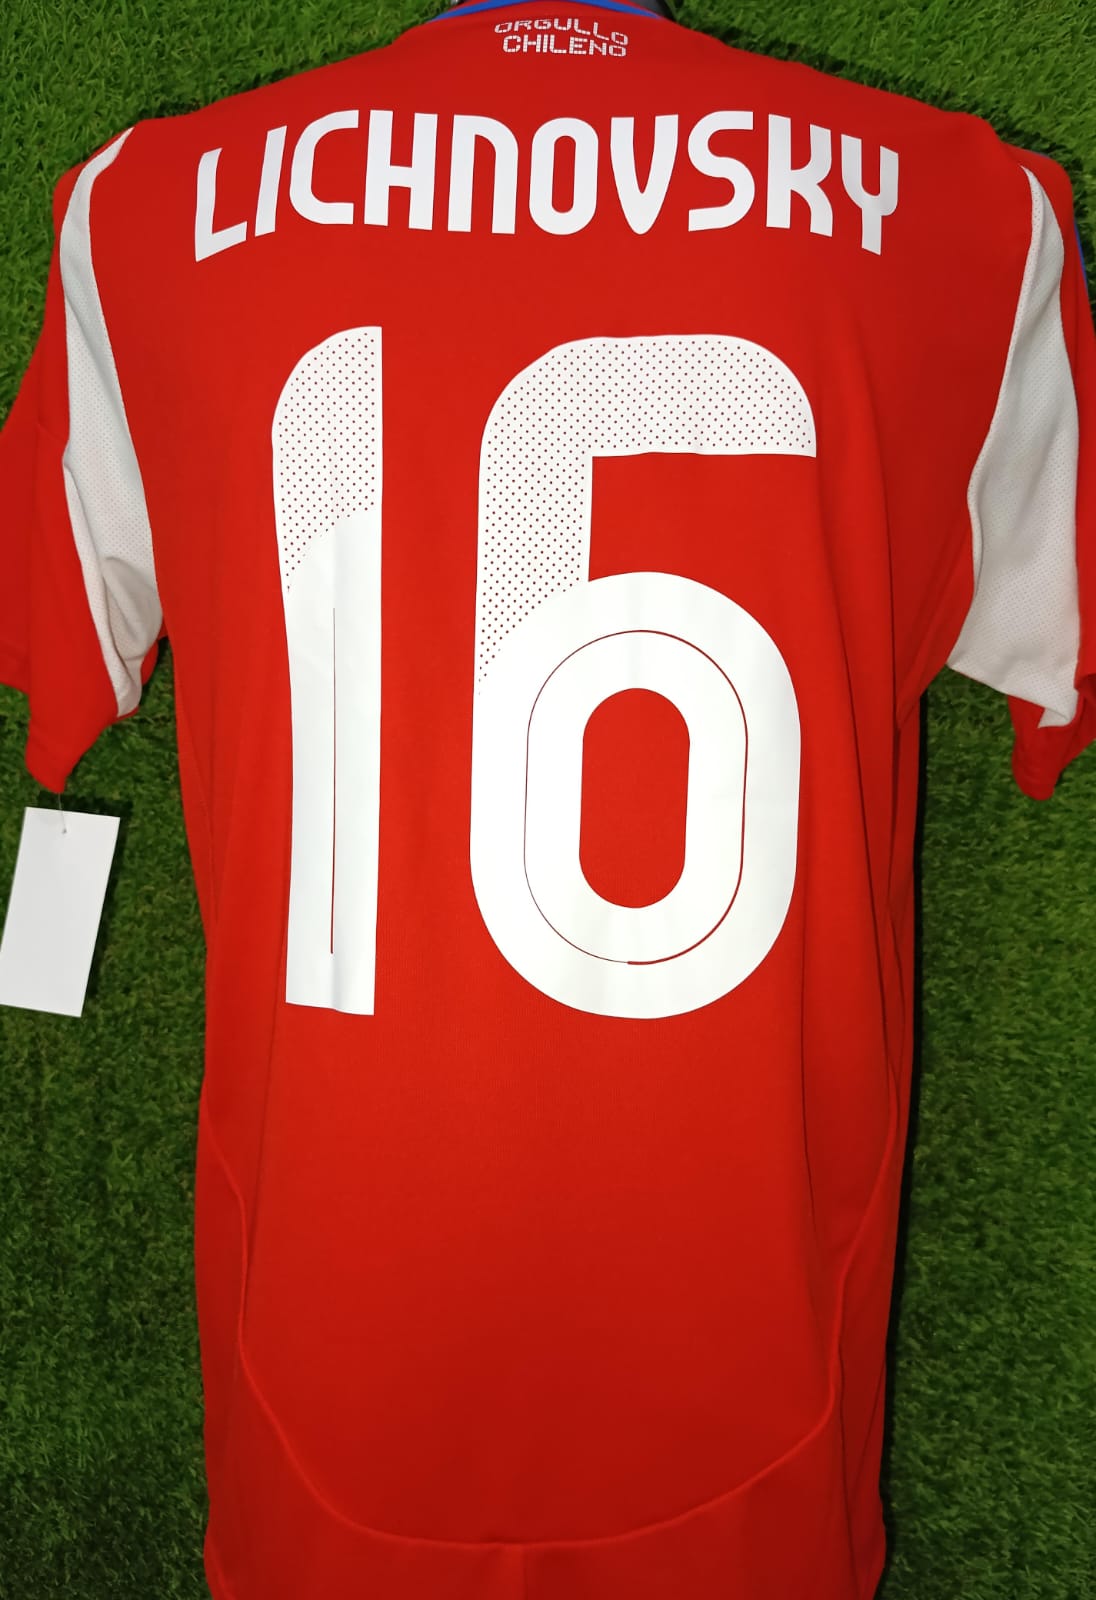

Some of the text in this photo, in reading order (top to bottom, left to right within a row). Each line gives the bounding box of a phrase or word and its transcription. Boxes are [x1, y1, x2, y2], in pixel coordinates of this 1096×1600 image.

[494, 18, 629, 46] ORGULLO
[502, 34, 627, 57] CHILENO
[194, 109, 899, 262] LICHNOVSKY
[271, 325, 817, 1020] 16
